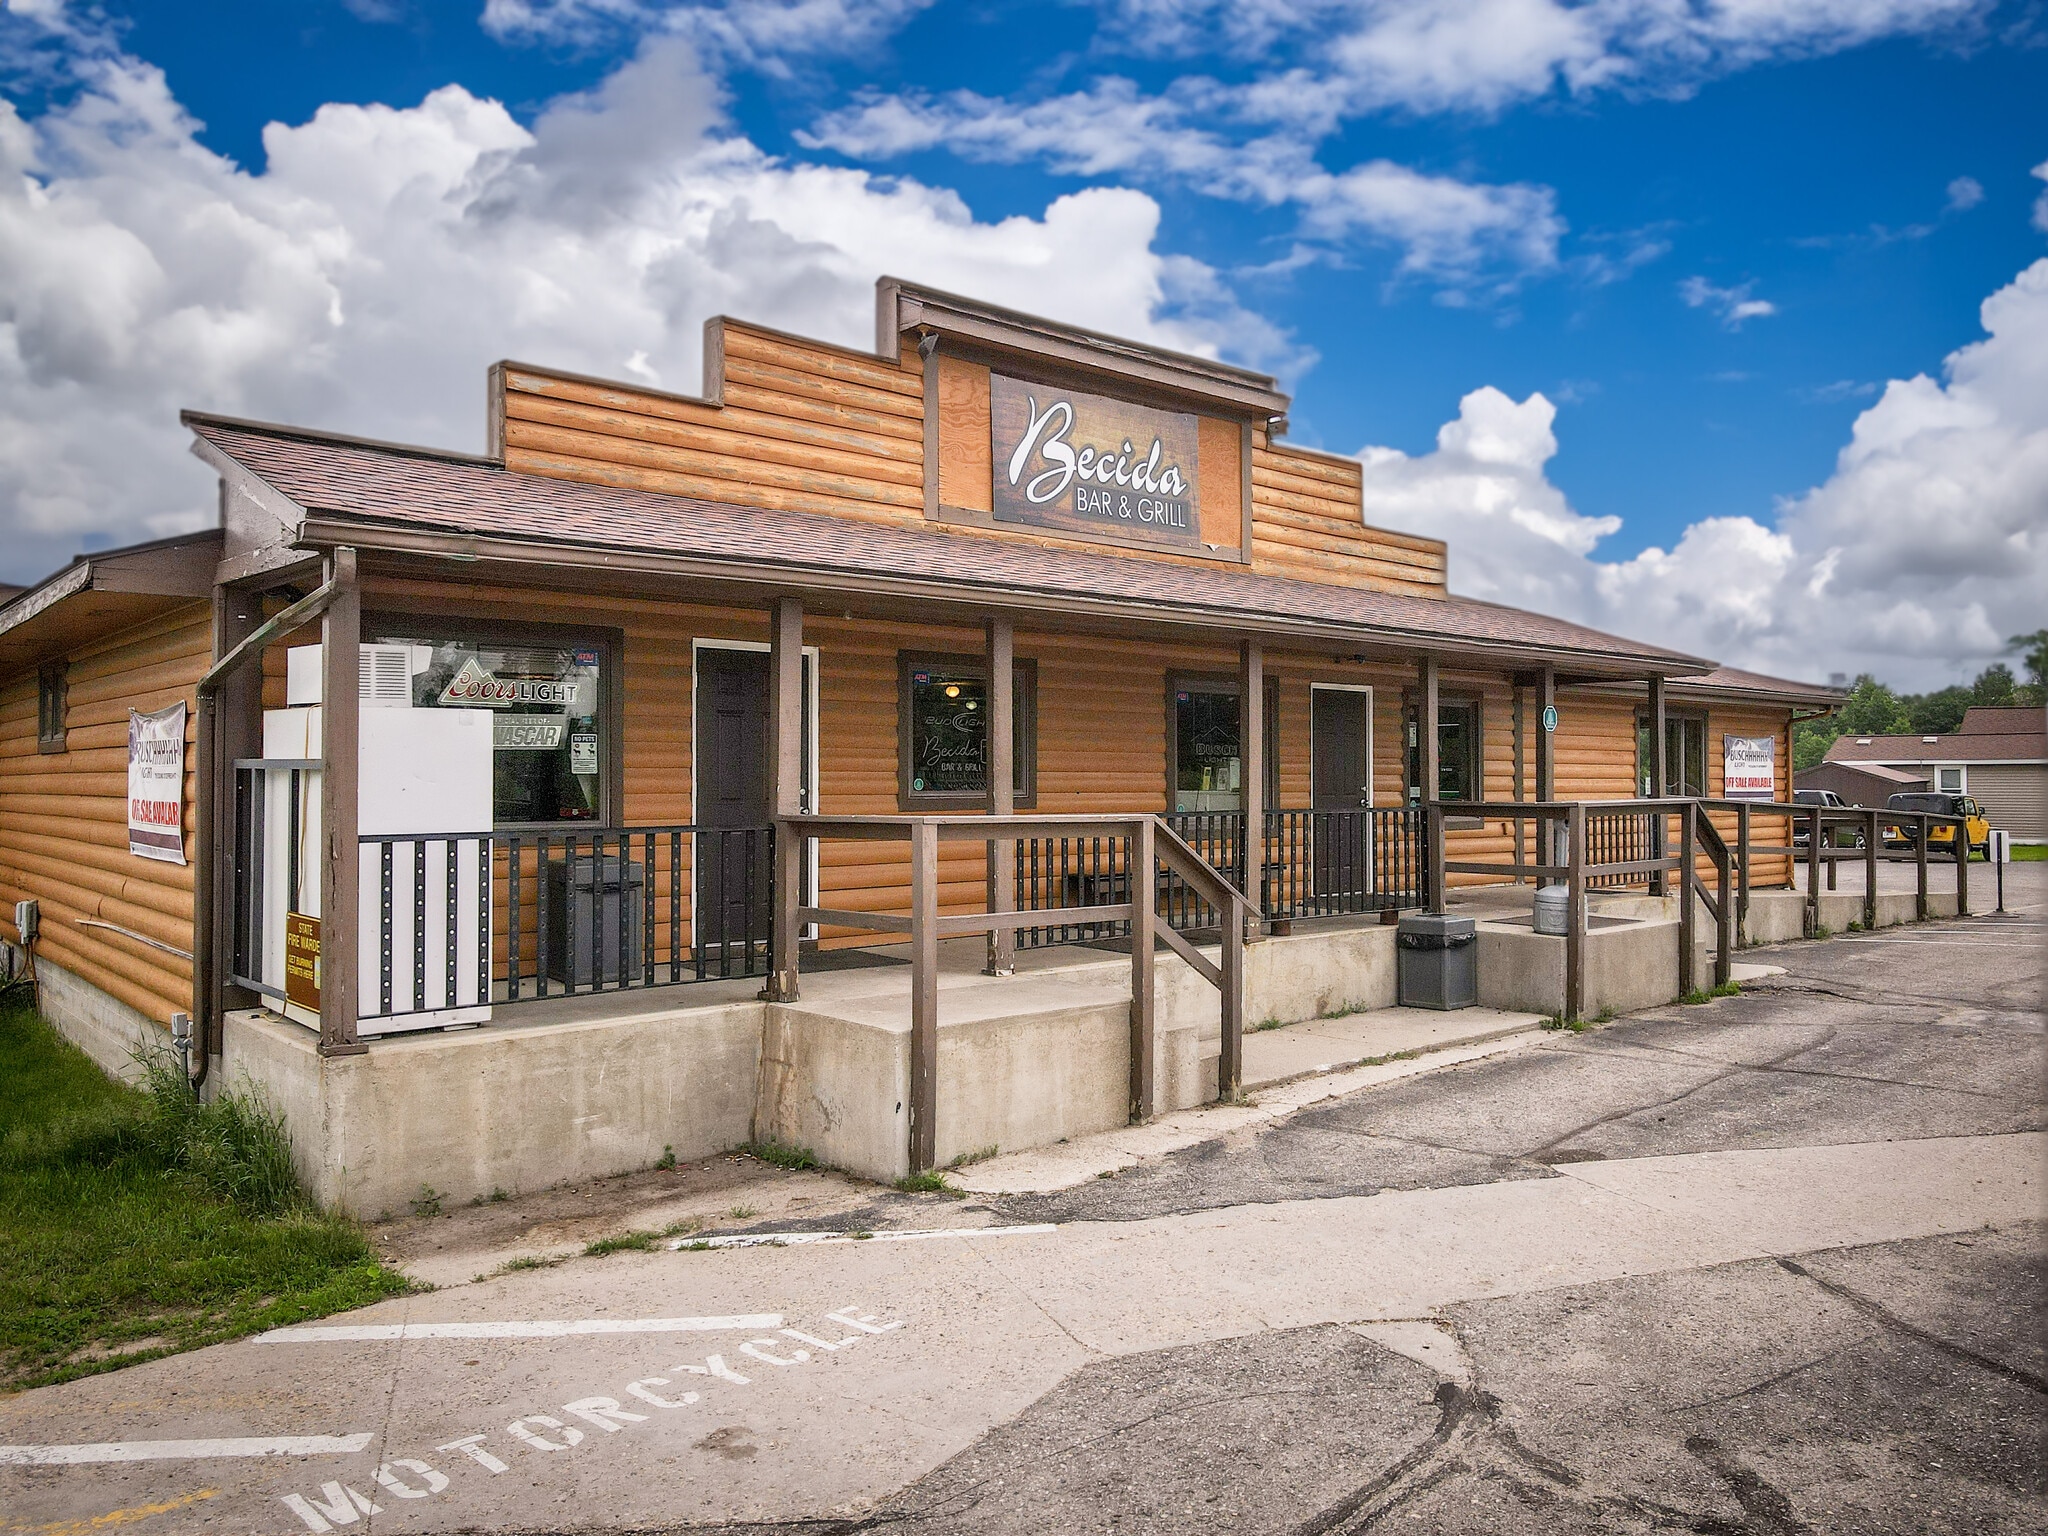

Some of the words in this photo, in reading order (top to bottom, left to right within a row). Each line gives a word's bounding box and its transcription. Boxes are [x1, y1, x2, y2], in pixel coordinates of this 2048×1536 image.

[1008, 396, 1187, 504] Becida
[1076, 487, 1113, 516] BAR
[1118, 494, 1132, 519] &
[1137, 498, 1186, 528] GRILL
[577, 653, 595, 661] ATM
[448, 671, 518, 700] Coors
[519, 682, 578, 703] LIGHT
[958, 718, 986, 727] LIGH
[922, 735, 980, 766] Becida
[1195, 742, 1238, 756] BUSCH
[941, 762, 955, 771] BAR
[964, 763, 982, 772] GRILL
[1735, 777, 1747, 788] SALE
[1748, 777, 1772, 788] AVAILABLE
[298, 923, 313, 936] STATE
[288, 933, 300, 947] FIRE
[301, 936, 321, 953] WARDE
[295, 956, 313, 969] BURNING
[287, 964, 303, 977] PERMITS
[302, 969, 314, 981] HERE
[280, 1304, 905, 1533] MOTORCYCLE
